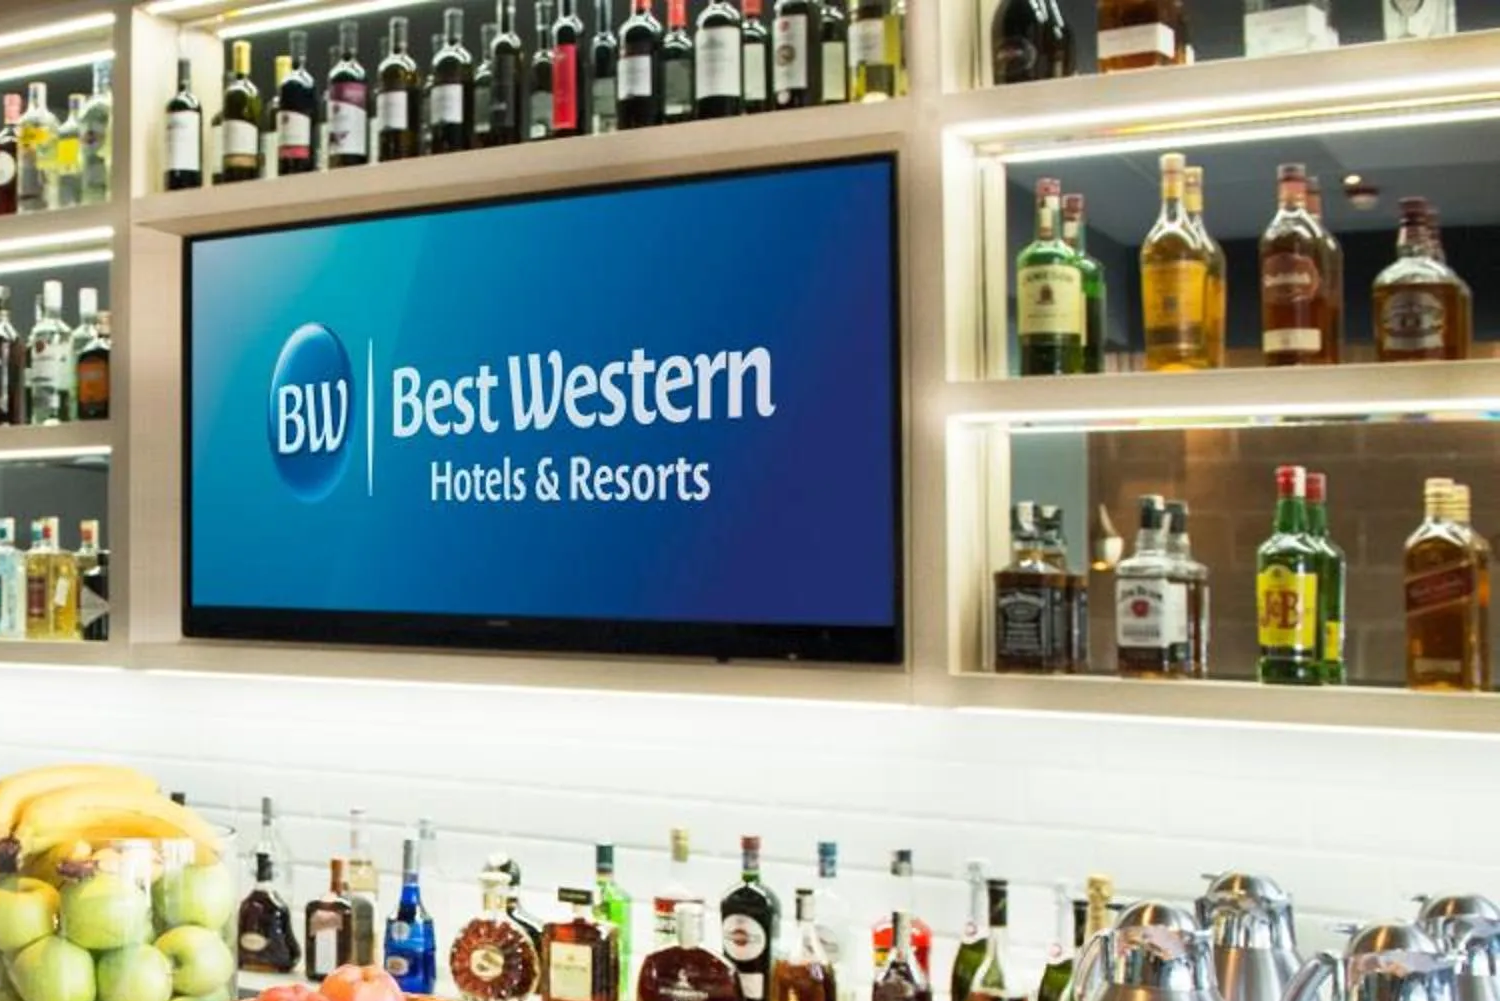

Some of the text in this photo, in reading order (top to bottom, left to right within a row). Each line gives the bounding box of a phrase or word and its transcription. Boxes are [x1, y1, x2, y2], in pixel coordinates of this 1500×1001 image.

[277, 379, 349, 455] BW
[392, 346, 776, 437] Best Western
[430, 455, 711, 502] Hotels & Resorts
[1259, 589, 1300, 629] J&B
